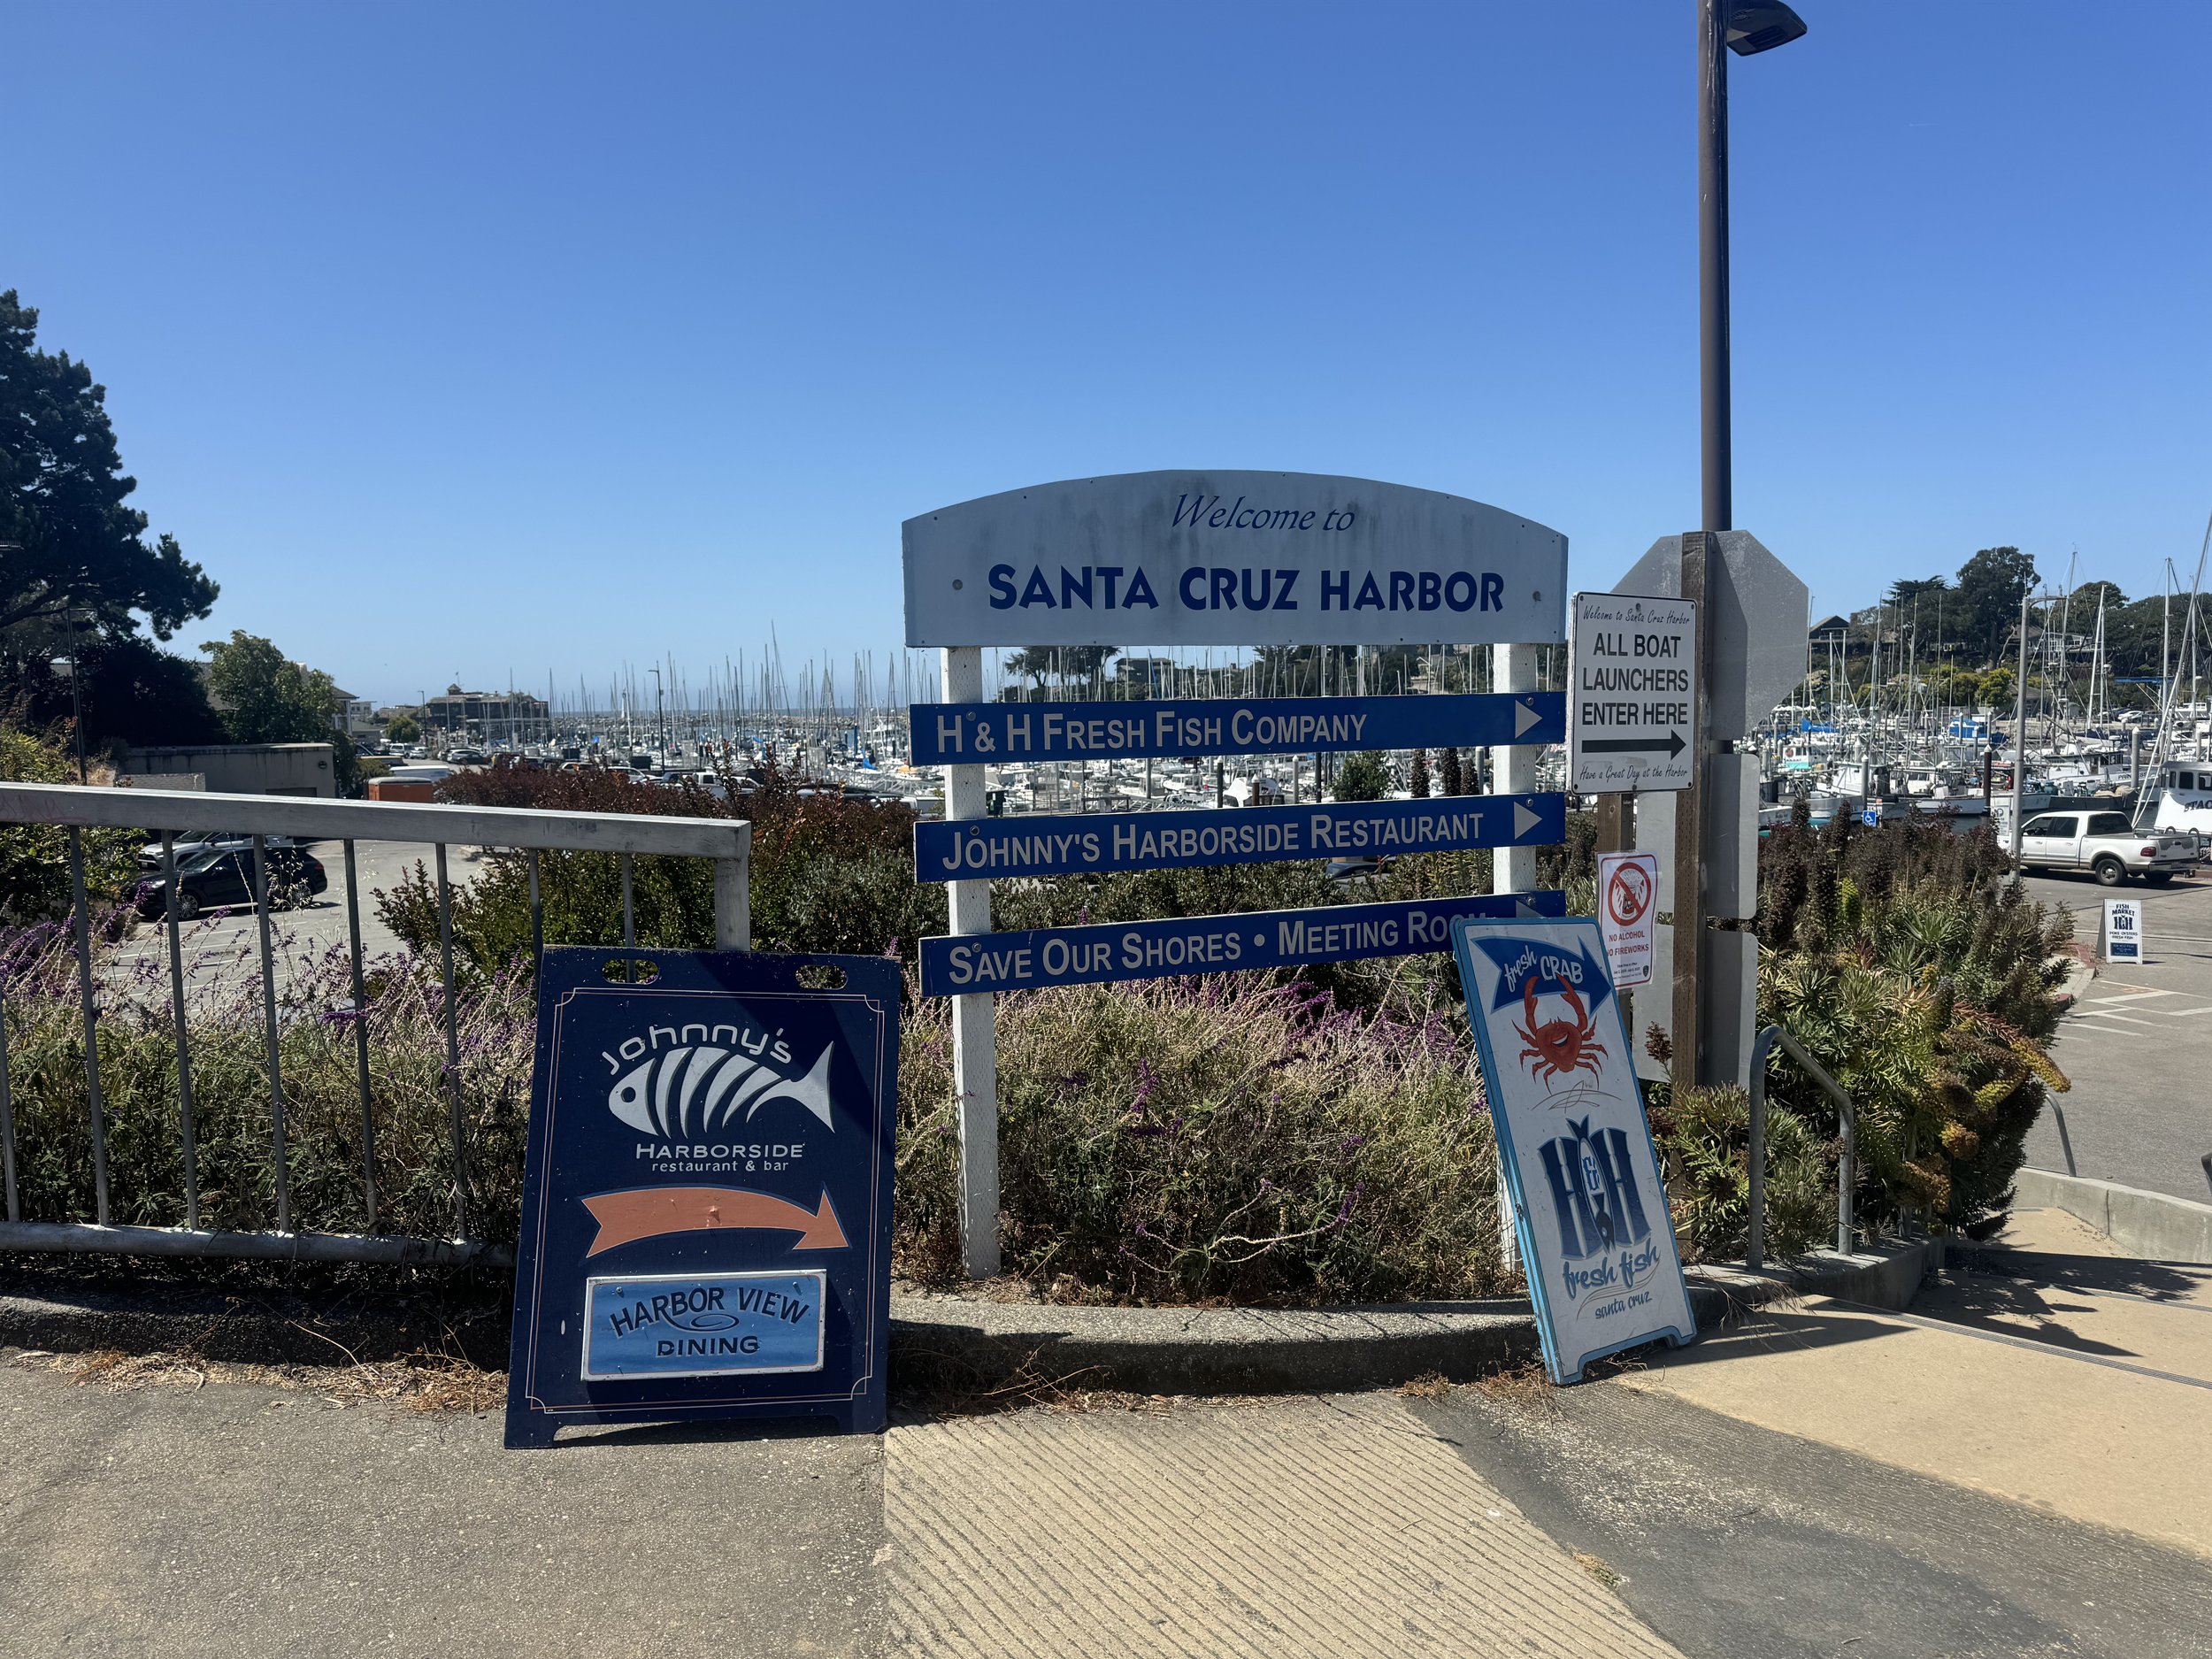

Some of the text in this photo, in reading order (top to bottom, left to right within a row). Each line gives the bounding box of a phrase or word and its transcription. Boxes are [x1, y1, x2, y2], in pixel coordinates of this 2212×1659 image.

[1171, 493, 1356, 532] Welcome to
[988, 563, 1505, 613] SANTA CRUZ HARBOR
[1584, 604, 1690, 625] Welcome to Santa Cruz Harbor
[1594, 633, 1681, 658] ALL BOAT
[1583, 667, 1689, 692] LAUNCHERS
[1582, 703, 1688, 726] ENTER HERE
[937, 709, 1367, 753] H & H FRESH FISH COMPANY
[1579, 764, 1596, 780] Have
[1605, 764, 1625, 783] Great
[1627, 764, 1640, 784] Day
[1642, 767, 1650, 778] at
[1652, 766, 1663, 777] the
[1664, 763, 1688, 778] Harbor
[942, 813, 1484, 870] JOHNNY'S HARBORSIDE RESTAURANT
[1618, 931, 1645, 940] ALCOHOL
[949, 946, 1033, 984] SAVE
[1042, 938, 1112, 975] OUR
[1121, 932, 1240, 969] SHORES
[1279, 919, 1399, 956] MEETING
[1615, 944, 1648, 955] FIREWORKS
[1504, 945, 1584, 993] fresh CRAB
[636, 1143, 804, 1159] HARBORSIDE
[651, 1160, 789, 1172] restaurant & bar
[1563, 1245, 1660, 1301] fresh fish
[610, 1286, 810, 1338] HARBOR VIEW
[1595, 1297, 1652, 1319] santa cruz
[657, 1335, 759, 1356] DINING
